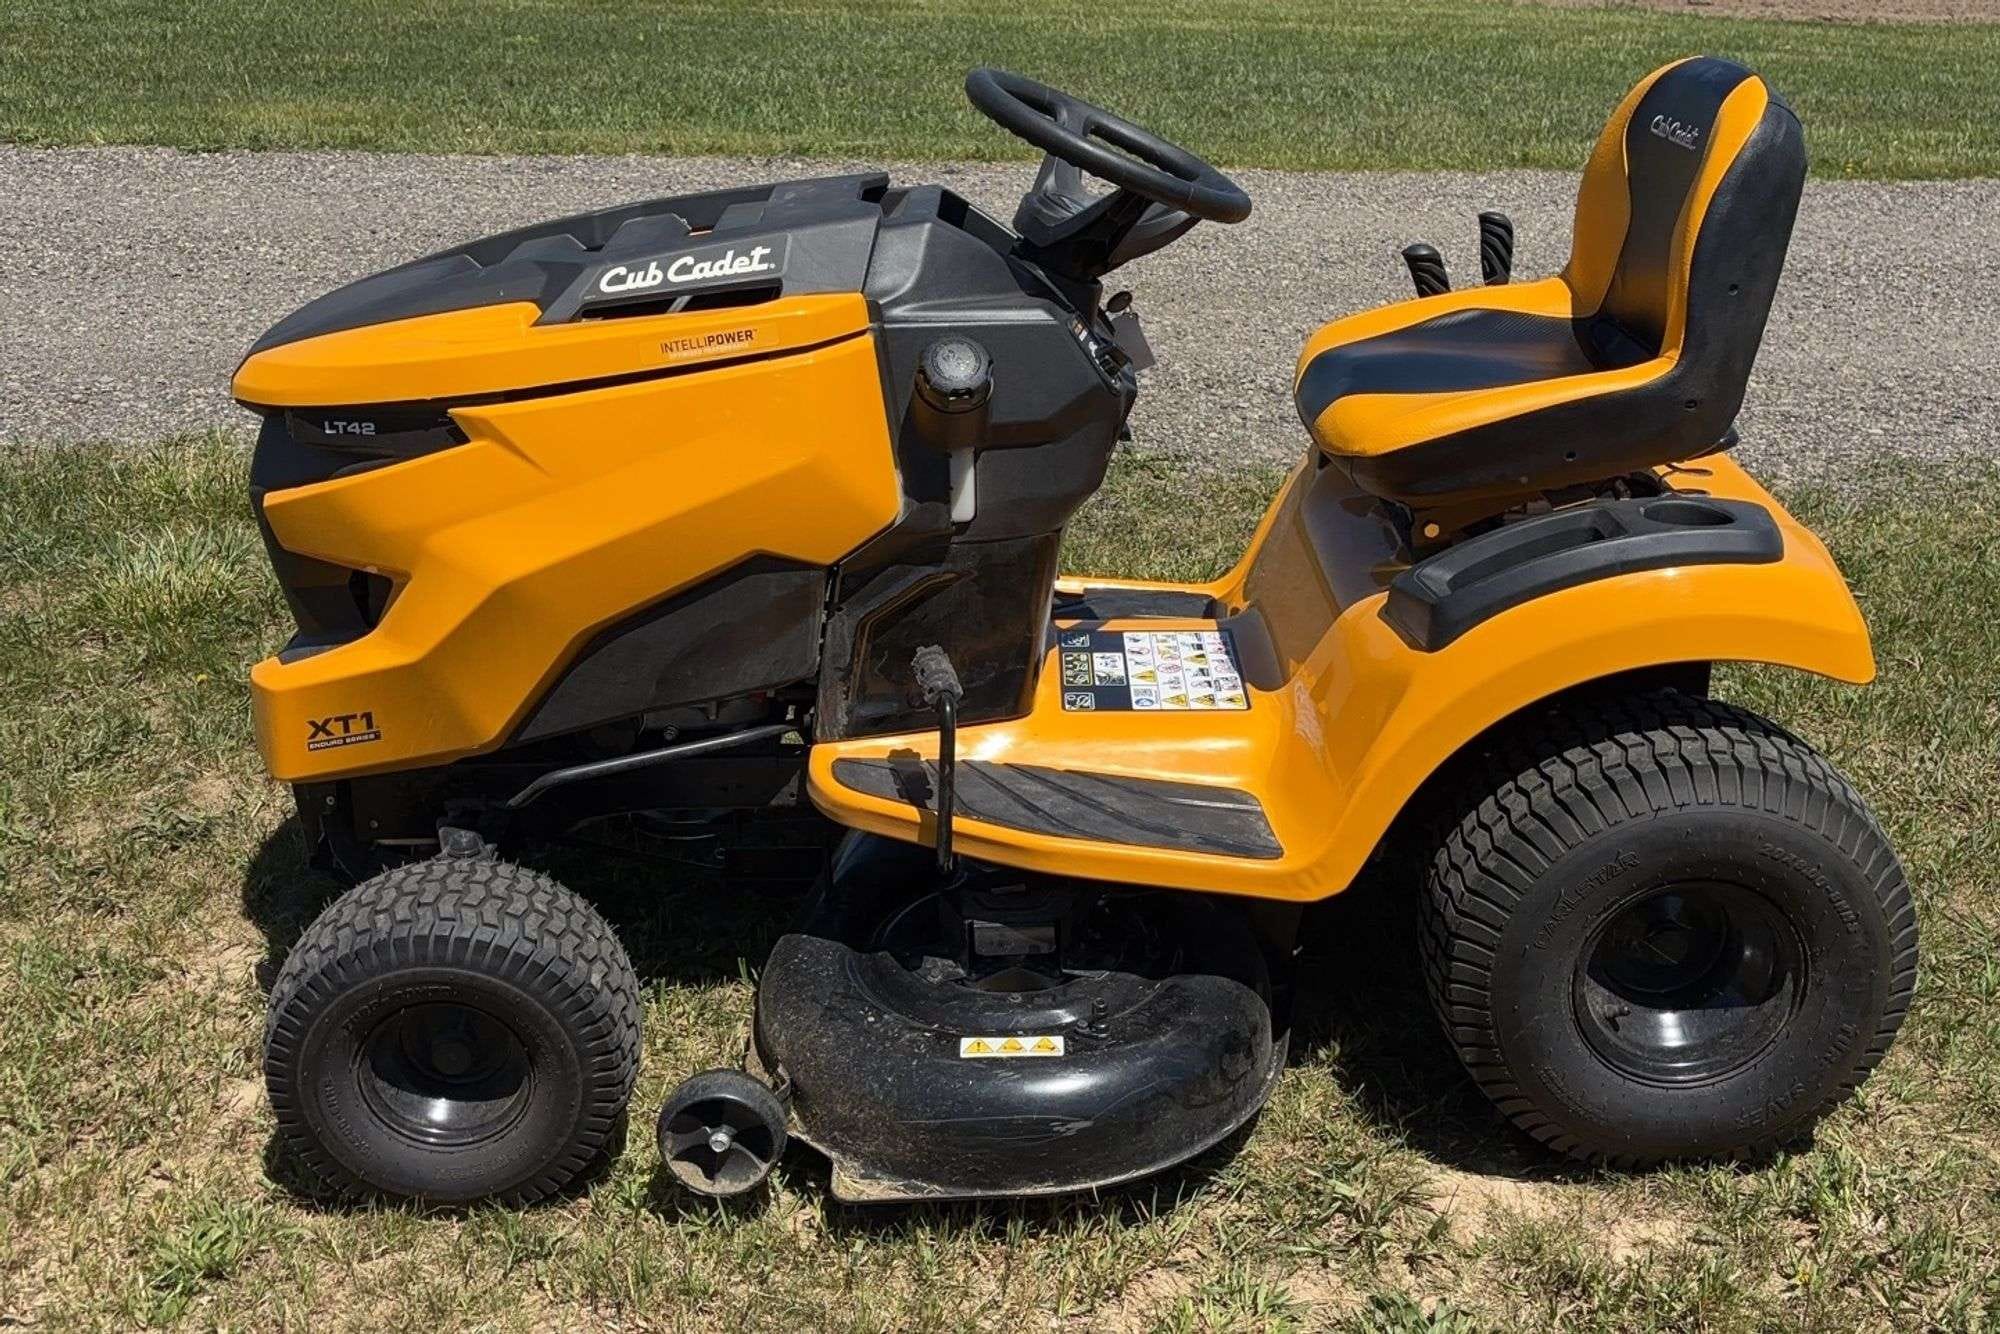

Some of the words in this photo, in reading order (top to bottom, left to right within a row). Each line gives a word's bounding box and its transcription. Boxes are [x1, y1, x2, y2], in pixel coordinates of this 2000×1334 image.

[600, 261, 663, 293] Cub
[667, 246, 772, 283] Cadet
[324, 421, 376, 436] LT42
[306, 712, 375, 740] XT1
